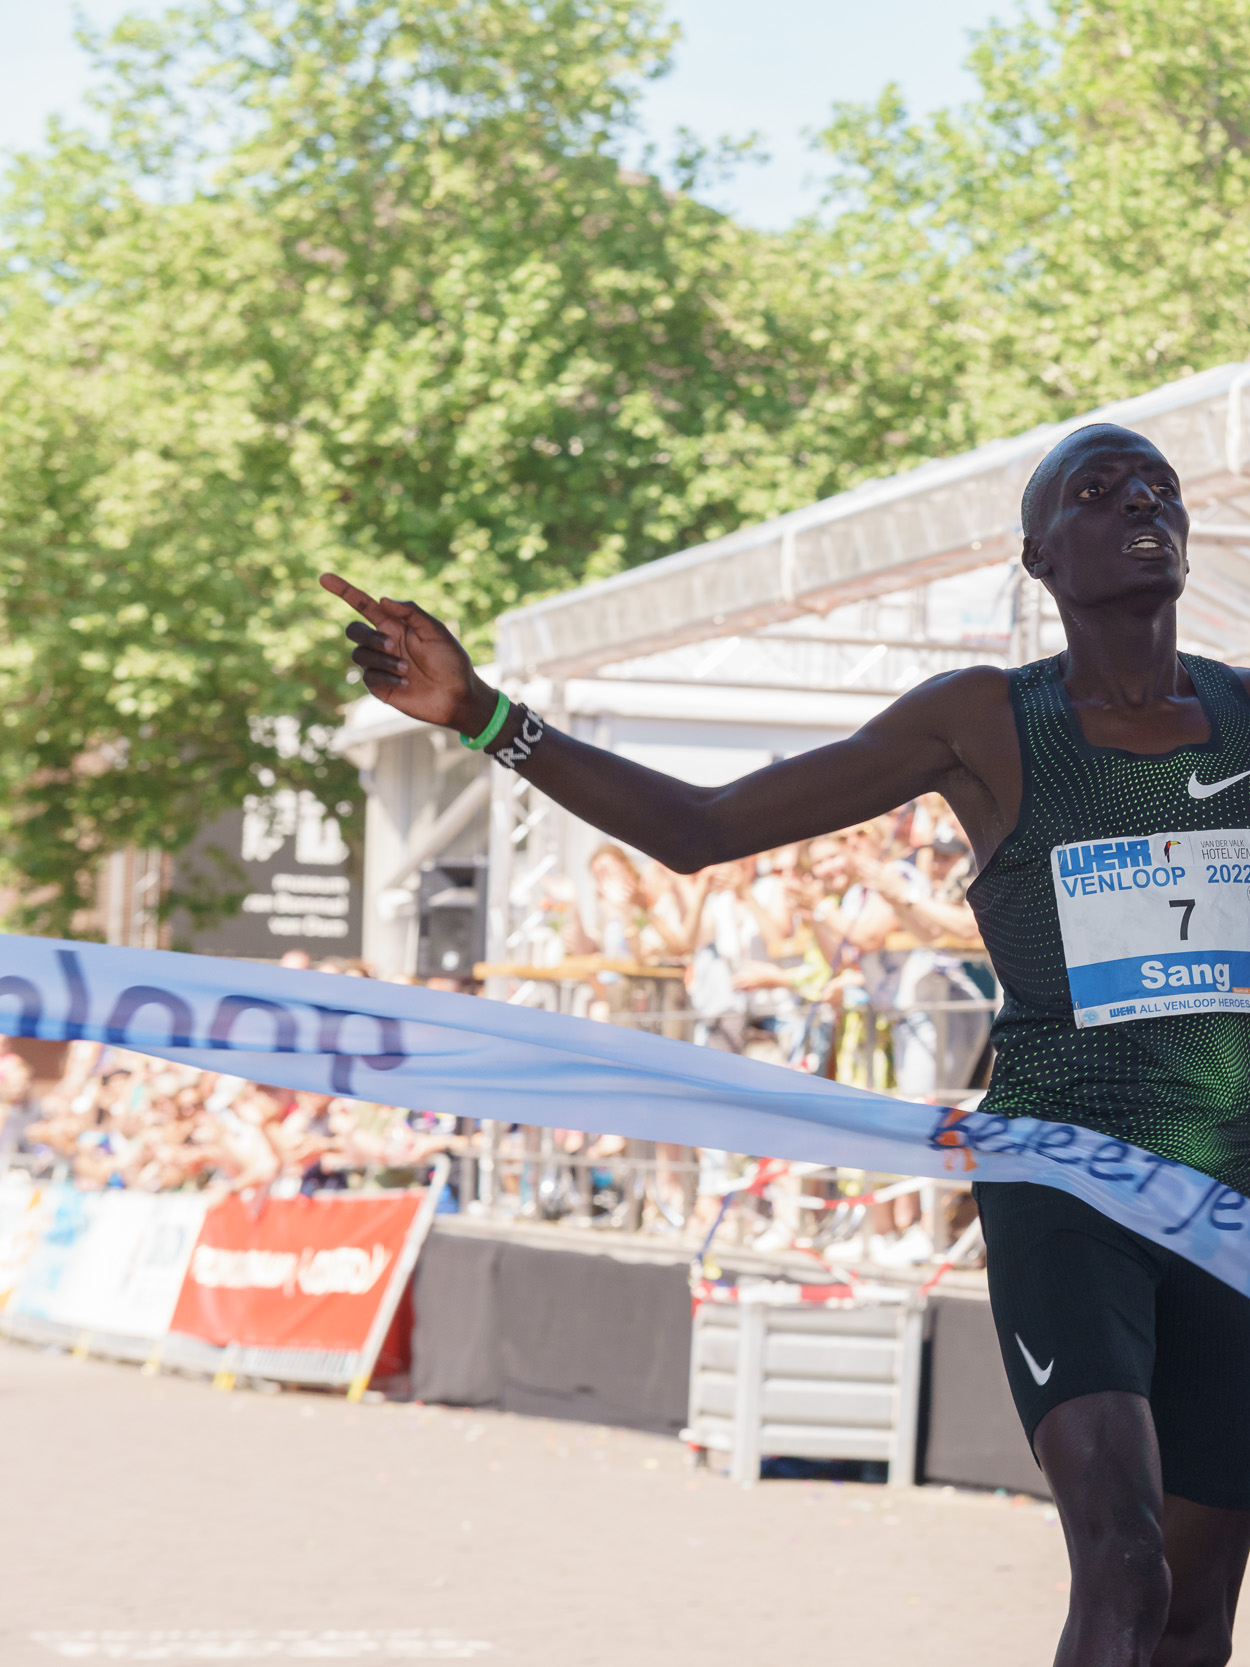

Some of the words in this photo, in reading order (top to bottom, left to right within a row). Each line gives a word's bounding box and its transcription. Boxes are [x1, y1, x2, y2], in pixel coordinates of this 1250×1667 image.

[1200, 840, 1215, 848] VAN
[1215, 839, 1228, 847] DER
[1229, 839, 1245, 847] VALK
[1202, 847, 1233, 860] HOTEL
[1061, 866, 1186, 898] VENLOOP
[1168, 898, 1196, 941] 7
[1140, 960, 1230, 992] Sang
[1139, 1001, 1162, 1014] ALL
[1164, 998, 1217, 1011] VENLOOP
[1218, 997, 1250, 1009] HEROES
